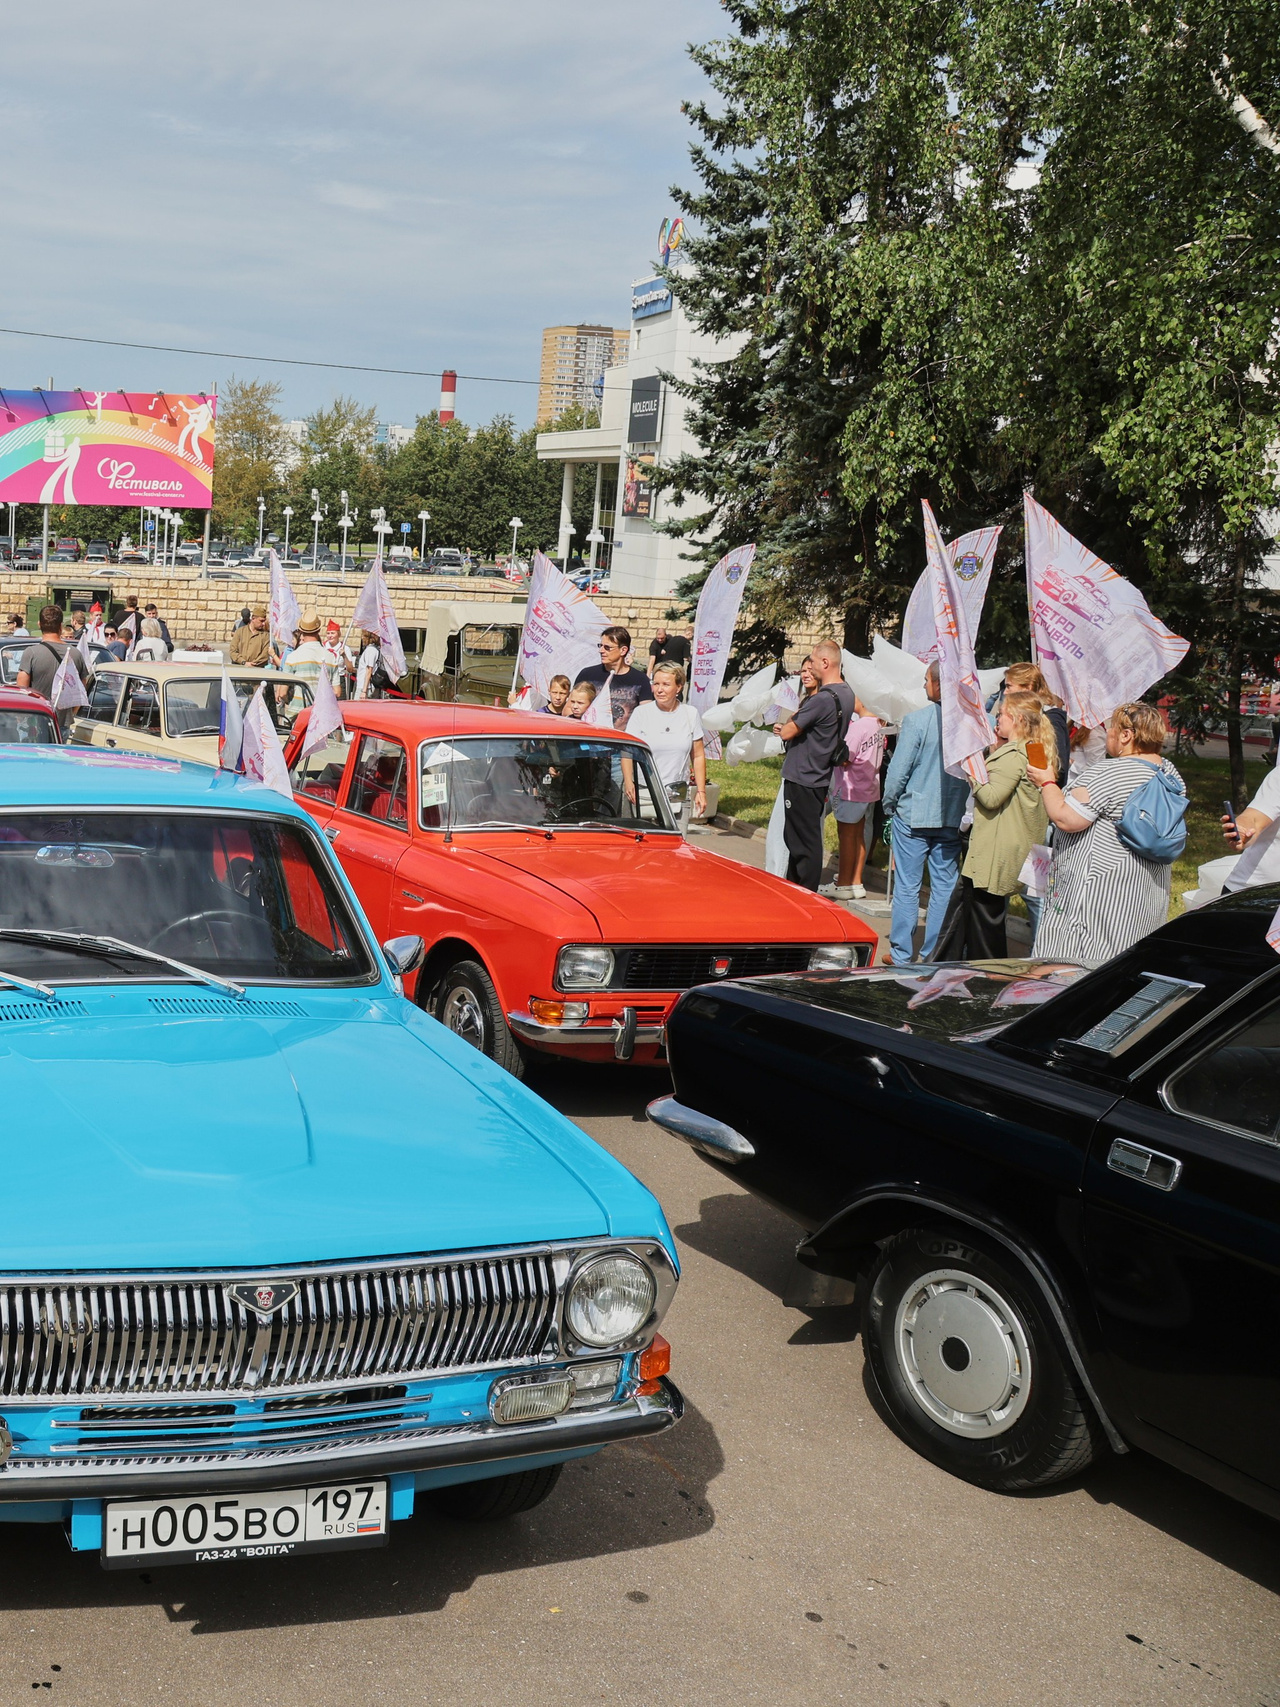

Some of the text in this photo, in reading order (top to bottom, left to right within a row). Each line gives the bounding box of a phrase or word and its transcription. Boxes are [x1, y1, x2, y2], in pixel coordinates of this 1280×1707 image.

[632, 400, 657, 413] MOLECULE
[97, 457, 183, 491] Фестиваль
[1036, 600, 1076, 634] РЕТРО
[530, 619, 550, 638] РЕТРО
[434, 774, 445, 784] 90
[311, 1486, 374, 1522] 197
[324, 1522, 355, 1535] RUS
[195, 1543, 295, 1562] ГАЗ-24 "ВОЛГА"
